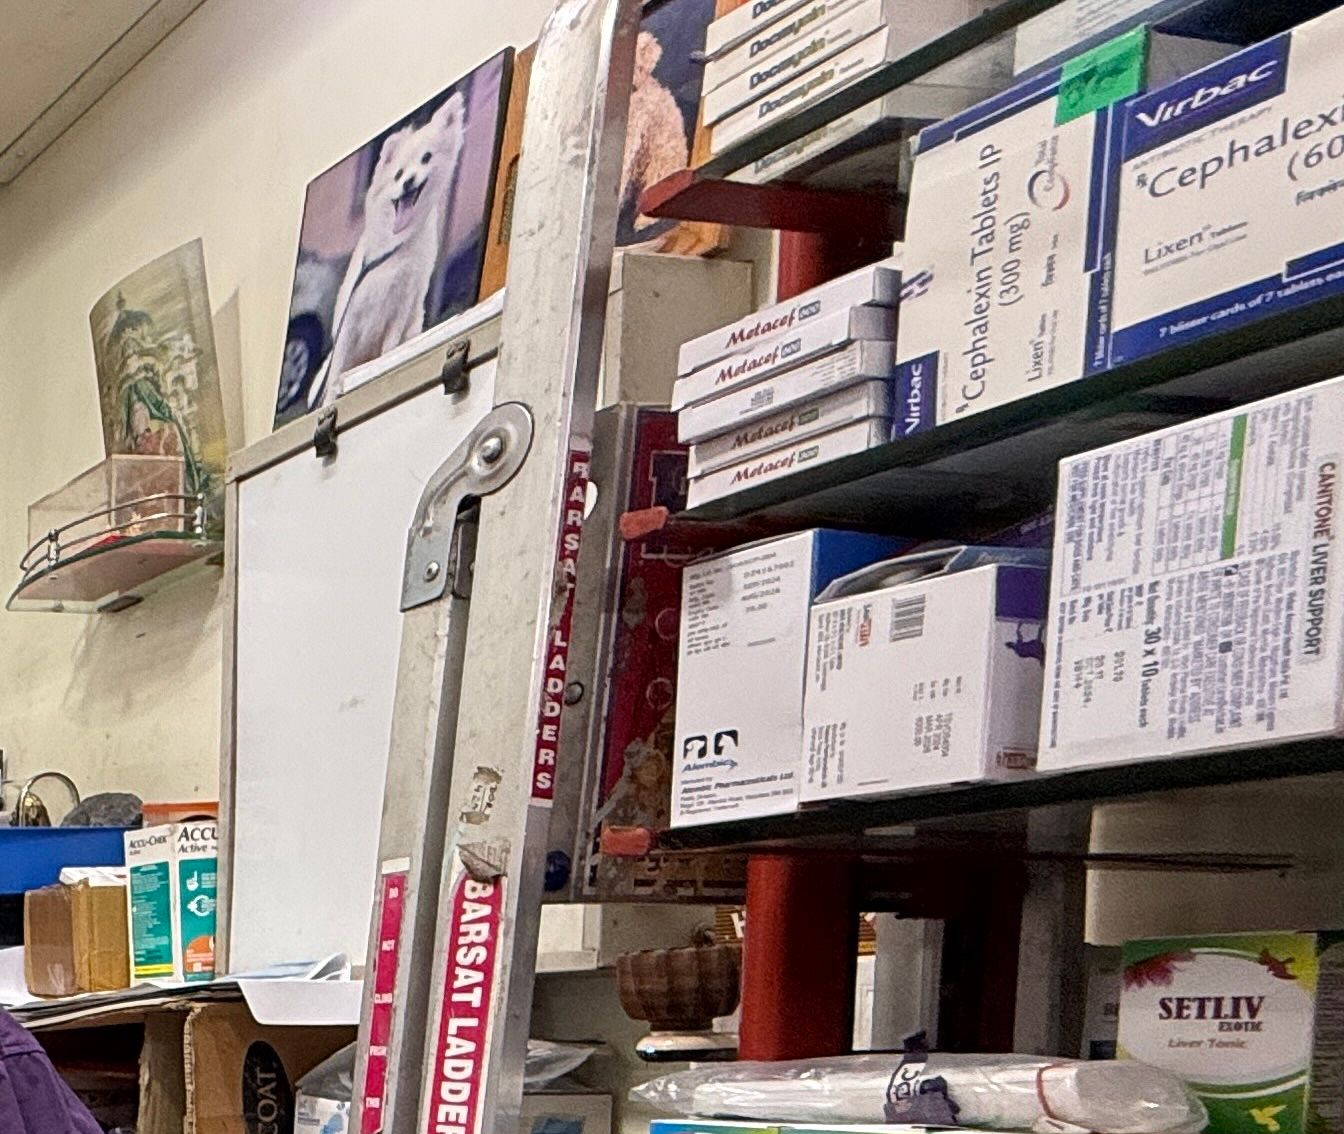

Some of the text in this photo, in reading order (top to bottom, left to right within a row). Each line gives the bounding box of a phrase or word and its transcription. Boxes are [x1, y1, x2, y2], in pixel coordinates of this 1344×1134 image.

[1136, 60, 1278, 127] Virbac
[998, 211, 1031, 306] (300 mg)
[1144, 231, 1203, 265] Lixen
[961, 143, 1002, 400] Cephalexin Tablets IP
[725, 308, 796, 349] Metacef
[715, 346, 779, 385] Metacef
[905, 363, 923, 434] Virbac
[732, 416, 797, 449] Metacef
[730, 453, 796, 485] Metacef
[1303, 462, 1335, 655] CANITONE LIVER SUPPORT
[1144, 627, 1160, 645] 30
[1142, 661, 1158, 678] 10
[537, 629, 568, 790] LADDERS
[178, 844, 208, 854] Active
[452, 880, 494, 1008] BARSAT
[1159, 995, 1266, 1021] SETLIV
[1168, 1038, 1248, 1050] Liver Tonic
[1218, 1021, 1263, 1033] EXOTIC
